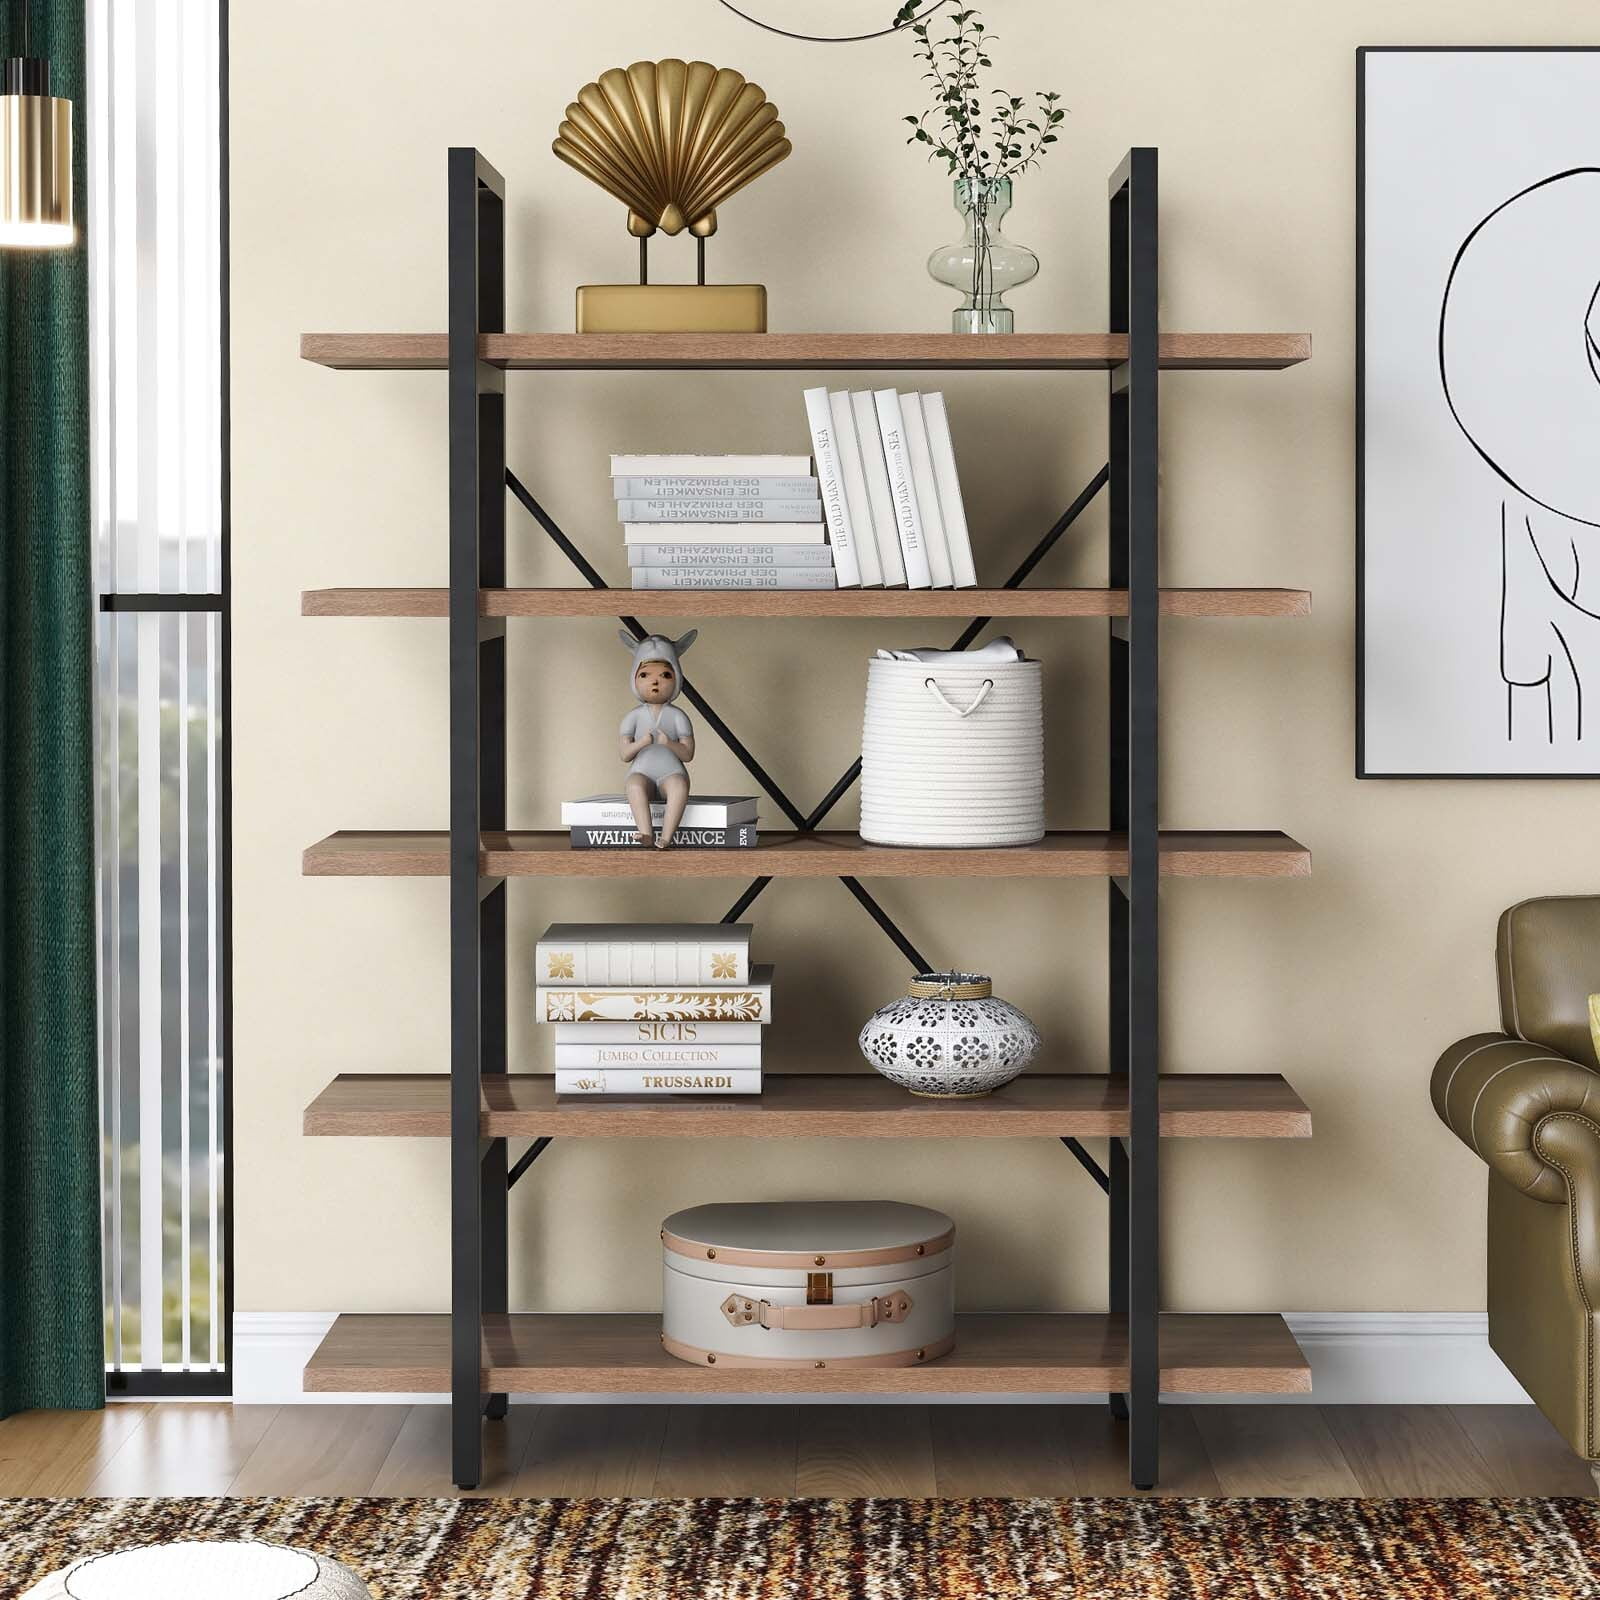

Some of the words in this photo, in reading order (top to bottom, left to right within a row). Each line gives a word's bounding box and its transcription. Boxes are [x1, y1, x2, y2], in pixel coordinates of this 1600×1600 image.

[817, 428, 830, 449] SEA
[887, 430, 900, 450] SEA
[643, 478, 730, 487] PRIMZAHLEN
[733, 478, 760, 487] DER
[655, 487, 735, 496] EINSAMKEIT
[738, 487, 760, 496] DIE
[826, 479, 840, 502] MAN
[896, 480, 910, 503] MAN
[647, 501, 733, 509] PRIMZAHLEN
[736, 501, 764, 509] DER
[659, 510, 738, 518] EINSAMKEIT
[742, 510, 764, 518] DIE
[831, 503, 844, 527] OLD
[902, 505, 914, 528] OLD
[835, 527, 848, 551] THE
[905, 529, 918, 552] THE
[658, 546, 743, 554] PRIMZAHLEN
[747, 546, 774, 554] DER
[671, 555, 748, 564] EINSAMKEIT
[753, 555, 774, 564] DIE
[661, 568, 747, 577] PRIMZAHLEN
[751, 568, 777, 577] DER
[672, 578, 752, 586] EINSAMKEIT
[756, 578, 777, 586] DIE
[739, 828, 748, 846] EVR
[638, 1023, 697, 1041] SICIS
[597, 1049, 639, 1063] JUMBO
[642, 1049, 719, 1062] COLLECTION
[642, 1076, 733, 1089] TRUSSARDI
